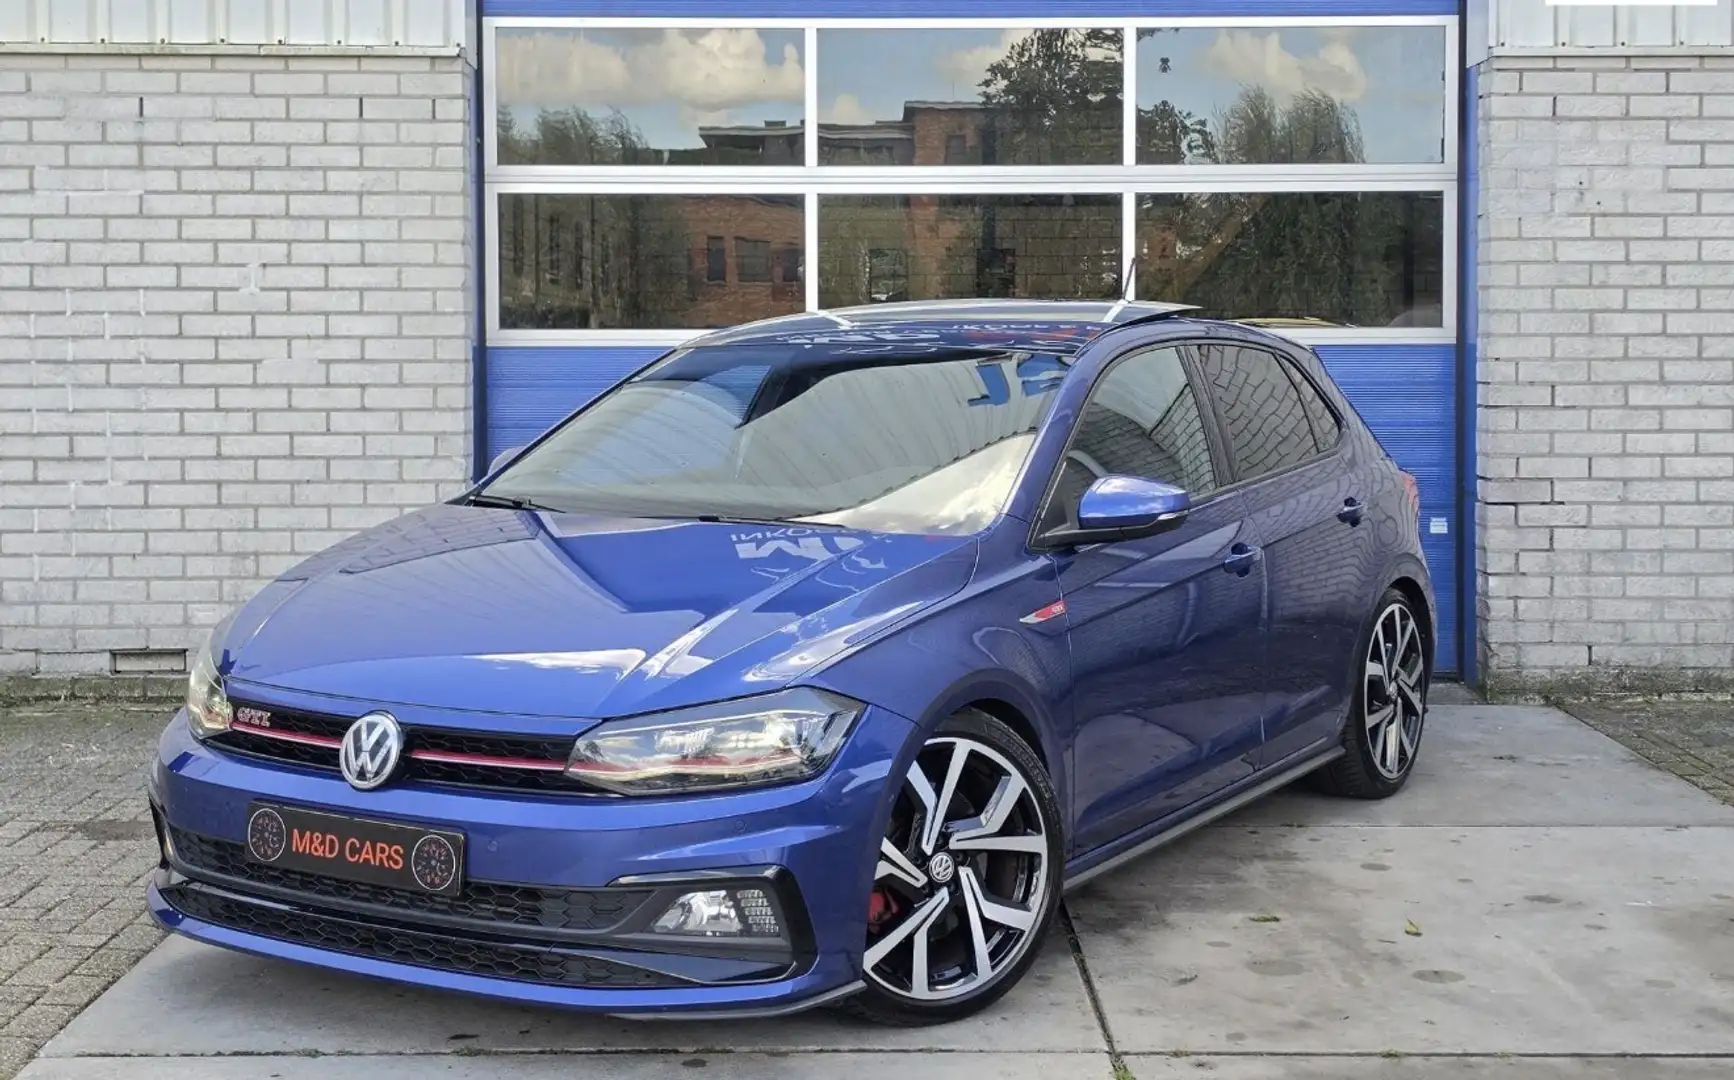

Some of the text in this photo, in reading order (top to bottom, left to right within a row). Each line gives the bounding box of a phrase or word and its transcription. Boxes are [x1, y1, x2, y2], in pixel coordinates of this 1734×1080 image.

[237, 706, 271, 728] GTI
[292, 828, 404, 870] M&D CARS
